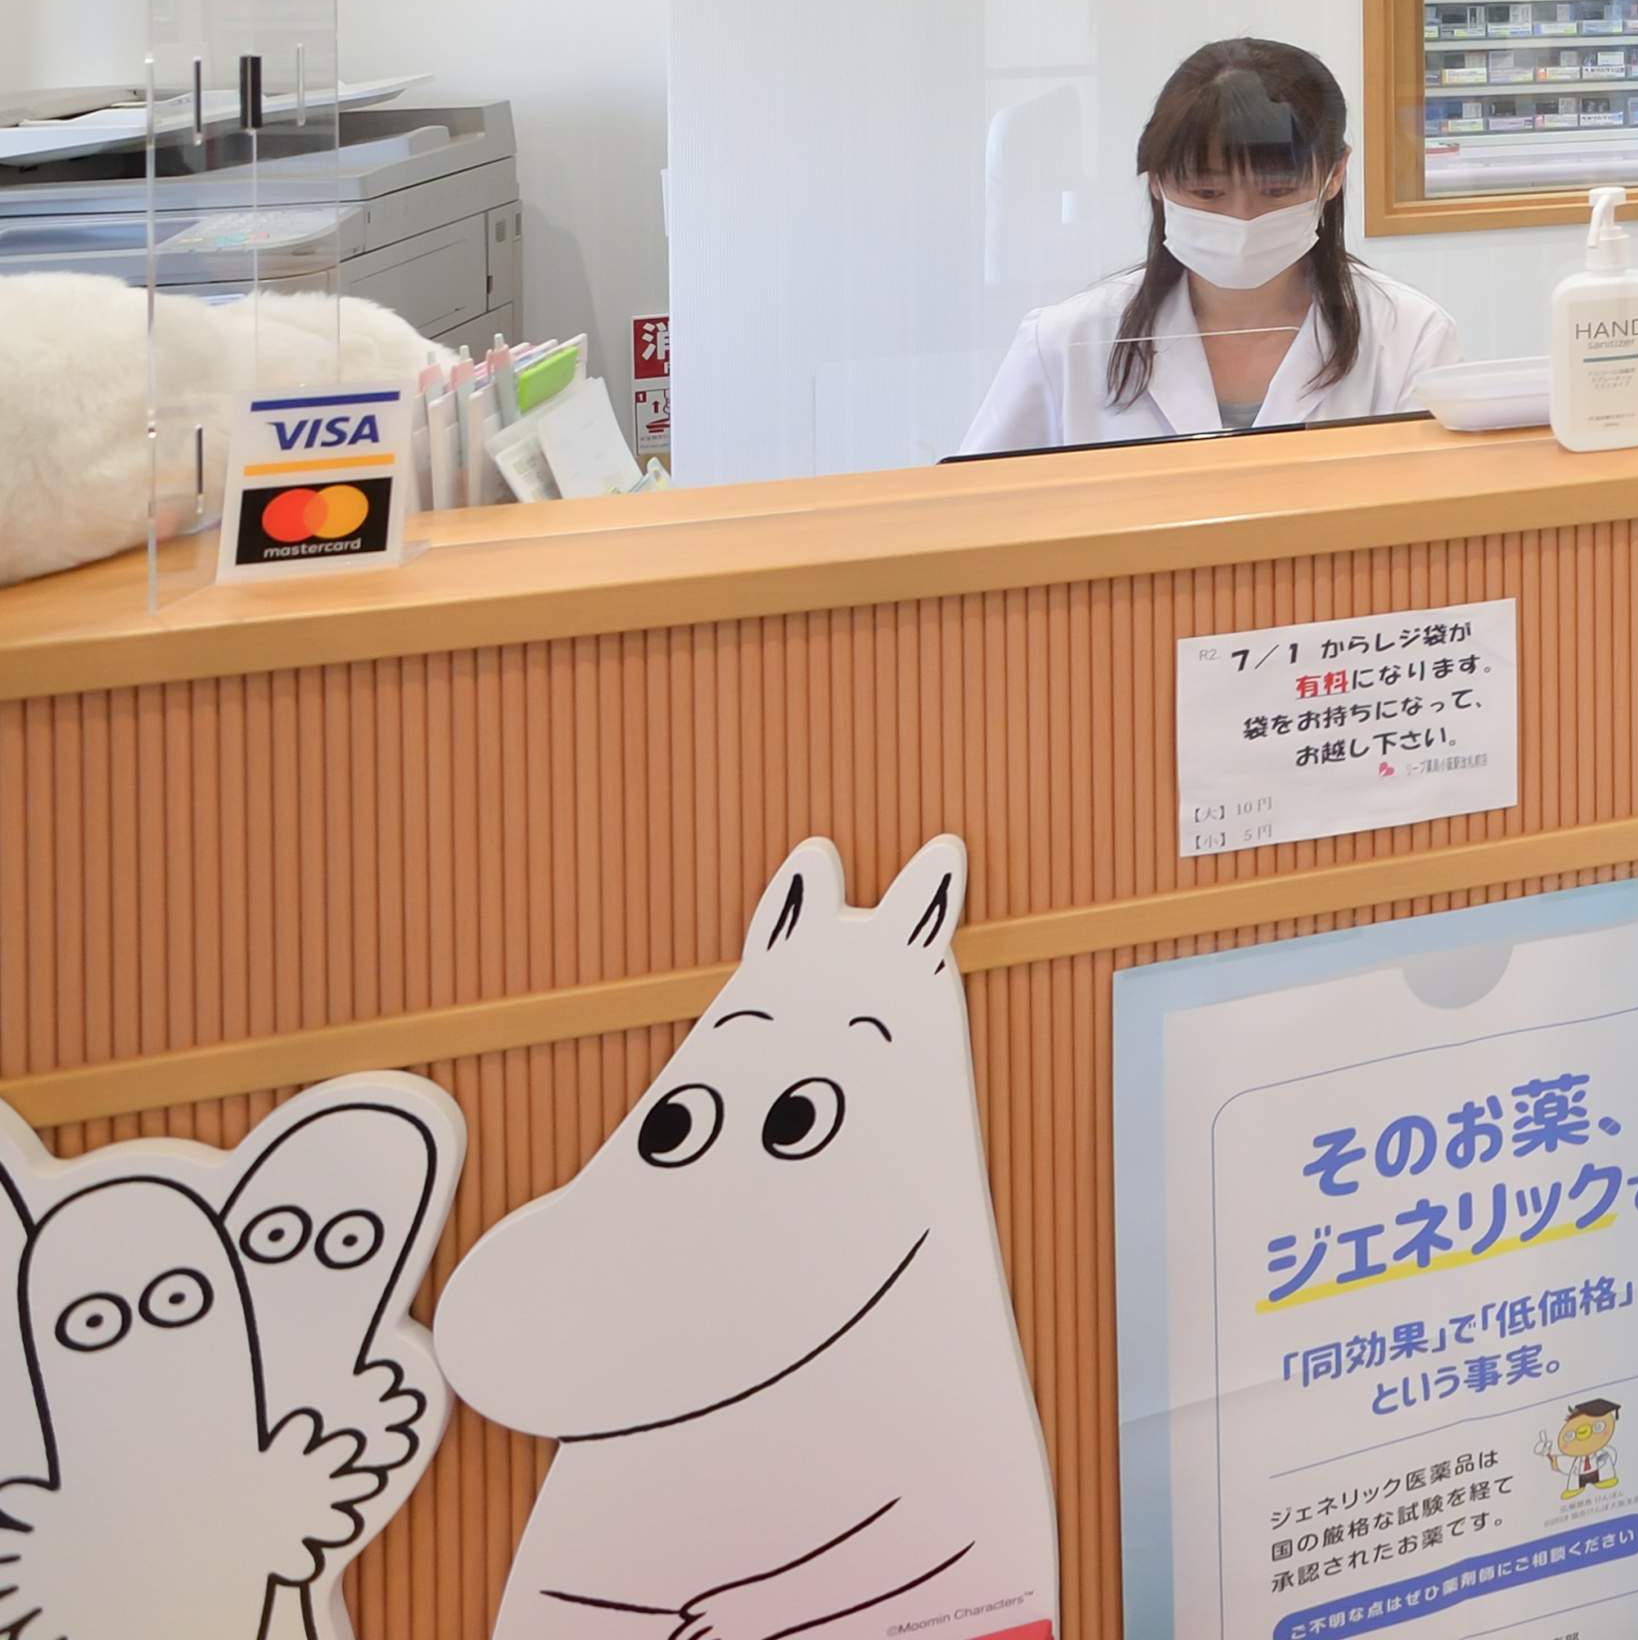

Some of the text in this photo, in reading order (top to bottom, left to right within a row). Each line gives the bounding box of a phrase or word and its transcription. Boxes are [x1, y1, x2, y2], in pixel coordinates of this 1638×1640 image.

[1587, 338, 1635, 350] sanitizer
[266, 413, 381, 450] VISA
[263, 536, 362, 559] mastercard
[1320, 621, 1473, 660] からレジ袋が
[1295, 654, 1492, 699] 有料になります。
[1242, 688, 1484, 741] 袋をお持ちになって、
[1295, 727, 1458, 767] お越し下さい。
[1300, 1071, 1623, 1197] そのお薬、
[1281, 1274, 1636, 1385] 「同効果」で「低価格」
[1371, 1344, 1561, 1416] という事実。
[1270, 1449, 1499, 1531] ジェネリック医薬品は
[1271, 1474, 1514, 1562] 国の厳格な試験を経て
[1270, 1510, 1506, 1594] 承認されたお薬です。
[1289, 1527, 1636, 1640] ご不明な点はぜひ薬剤師にご相談ください
